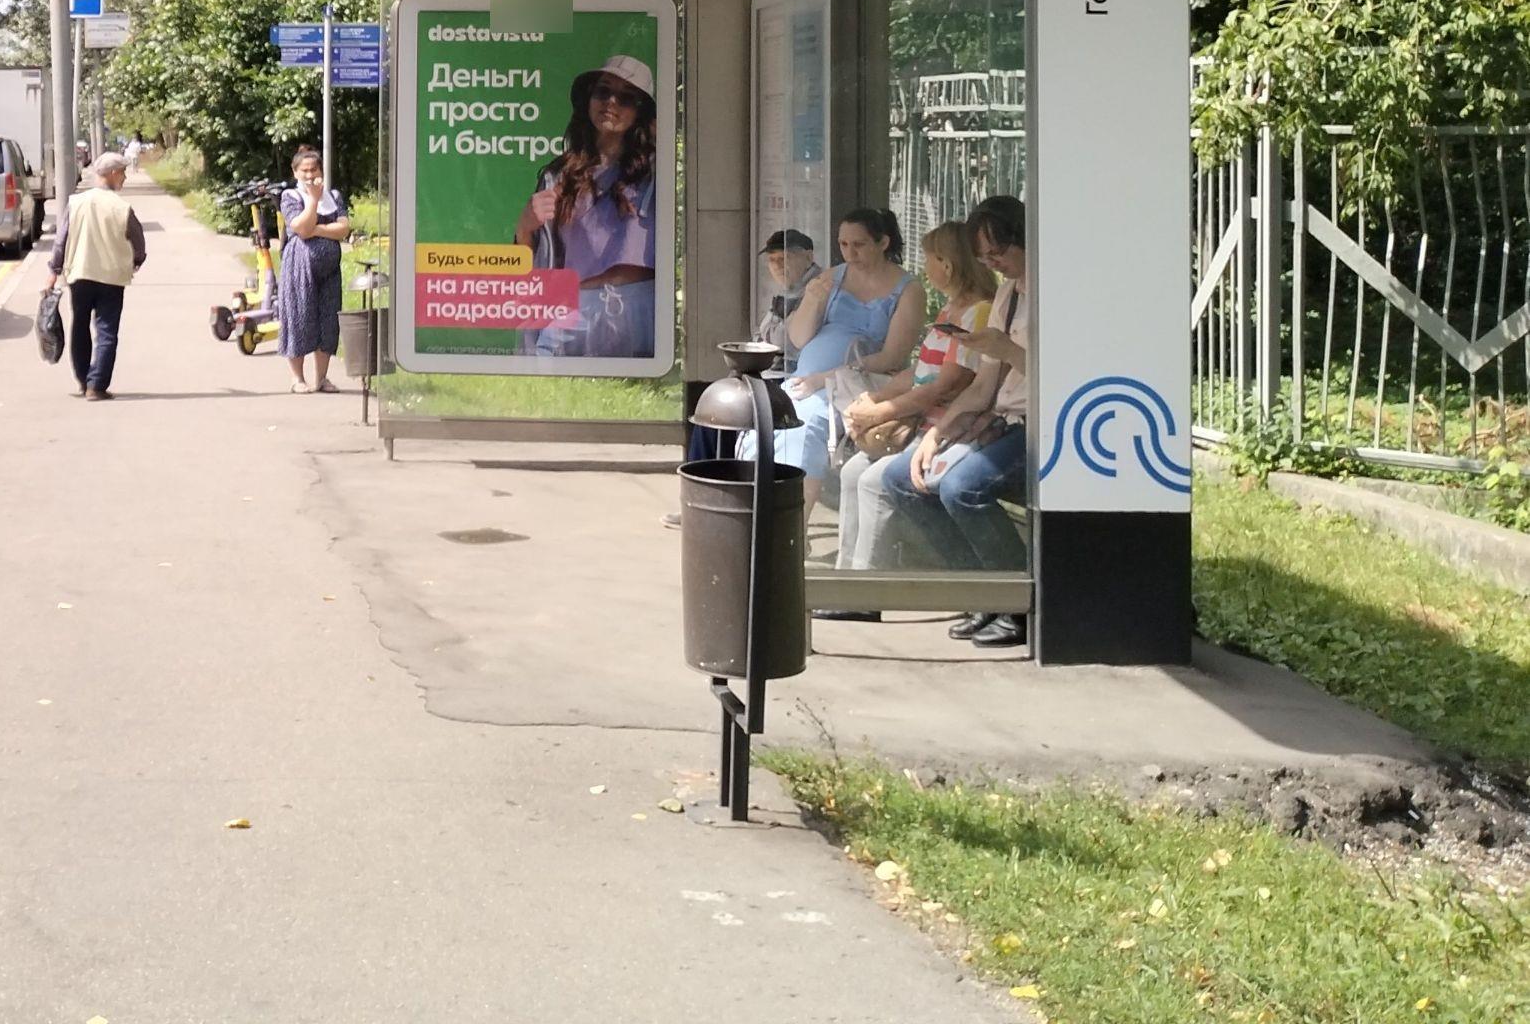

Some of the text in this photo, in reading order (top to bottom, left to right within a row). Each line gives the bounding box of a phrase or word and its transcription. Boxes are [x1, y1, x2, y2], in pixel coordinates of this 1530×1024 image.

[428, 63, 542, 92] Деньги
[429, 102, 540, 127] просто
[428, 135, 448, 154] и
[427, 252, 521, 266] Будь с нами
[427, 276, 543, 295] на летней
[427, 301, 567, 322] подработке
